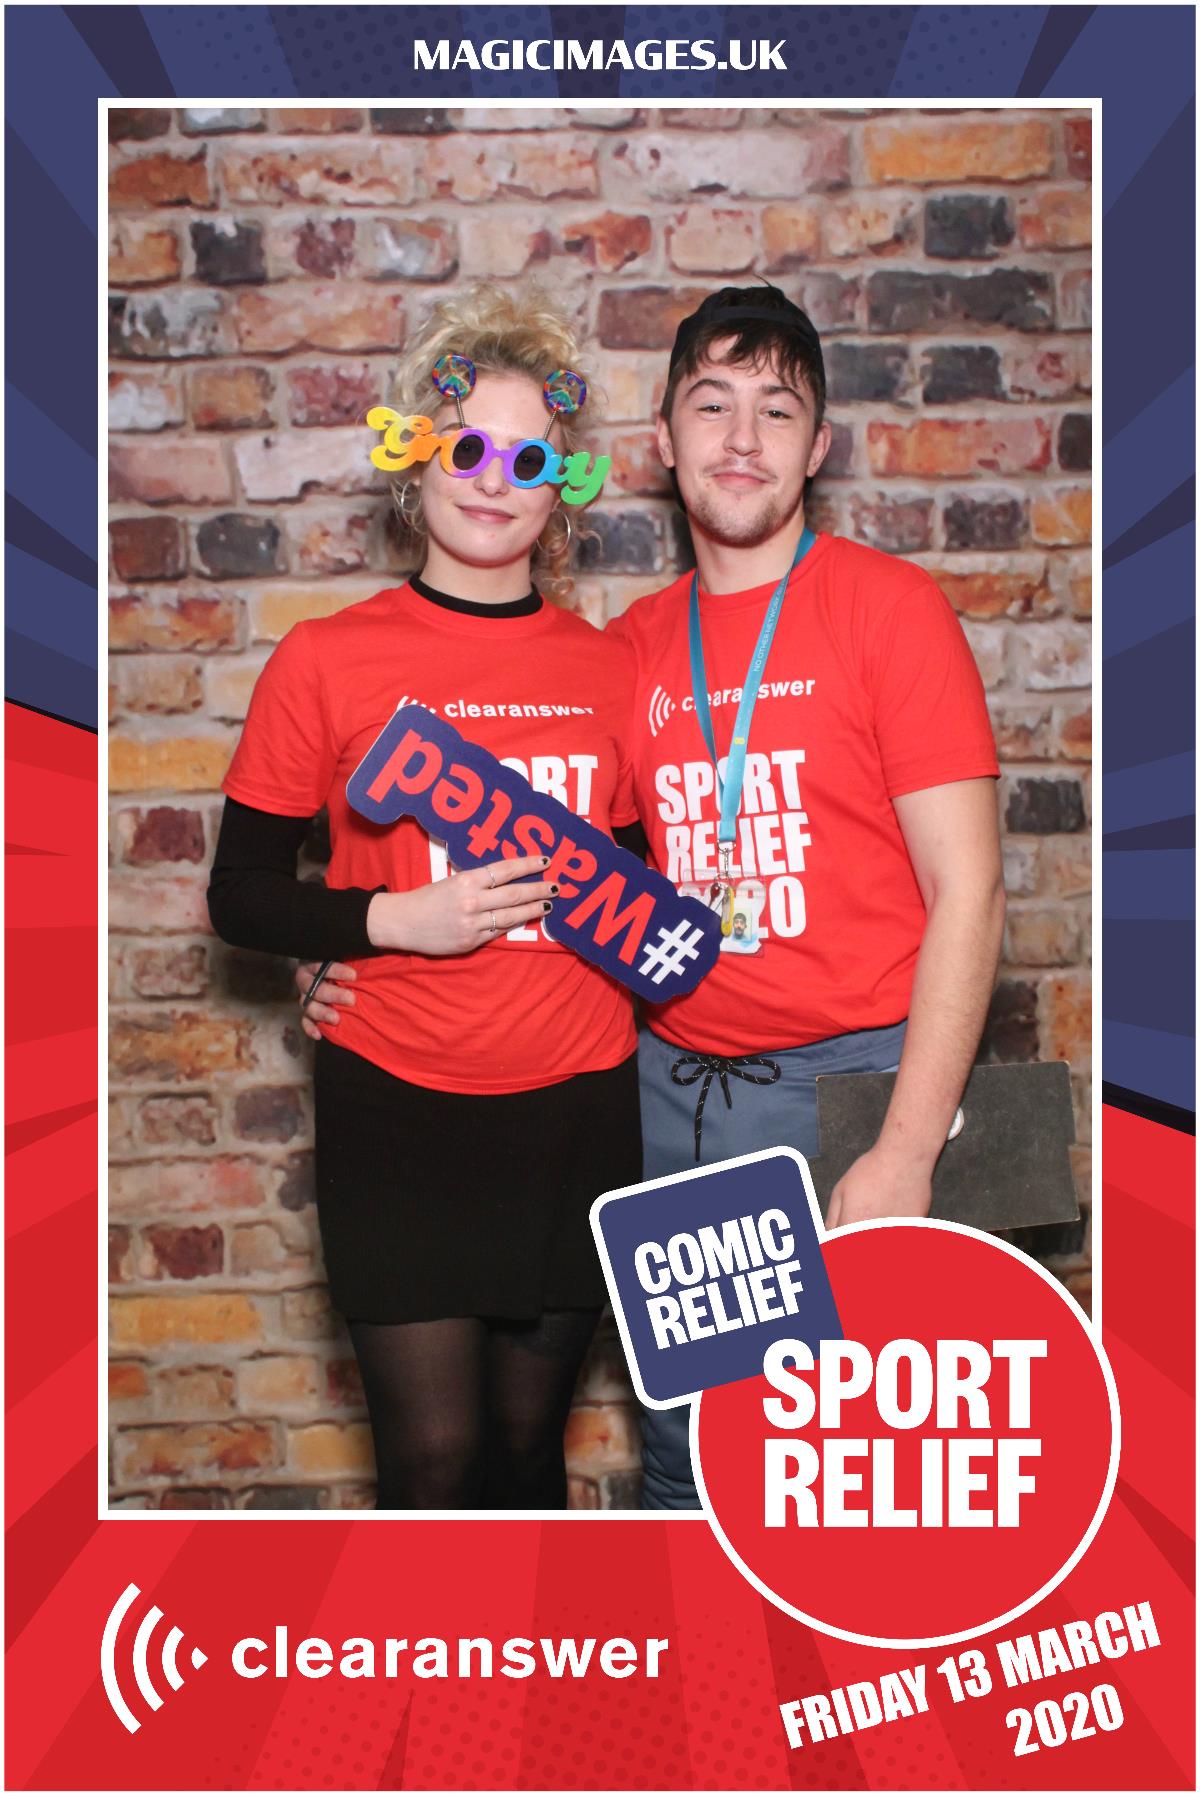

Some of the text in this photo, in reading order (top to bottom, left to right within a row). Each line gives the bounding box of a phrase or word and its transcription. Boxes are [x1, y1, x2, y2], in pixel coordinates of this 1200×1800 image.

[753, 660, 762, 672] NO
[443, 699, 594, 718] clearanswer
[681, 679, 815, 712] caraswer
[366, 729, 705, 985] #Wasted
[665, 811, 813, 883] RELIEF
